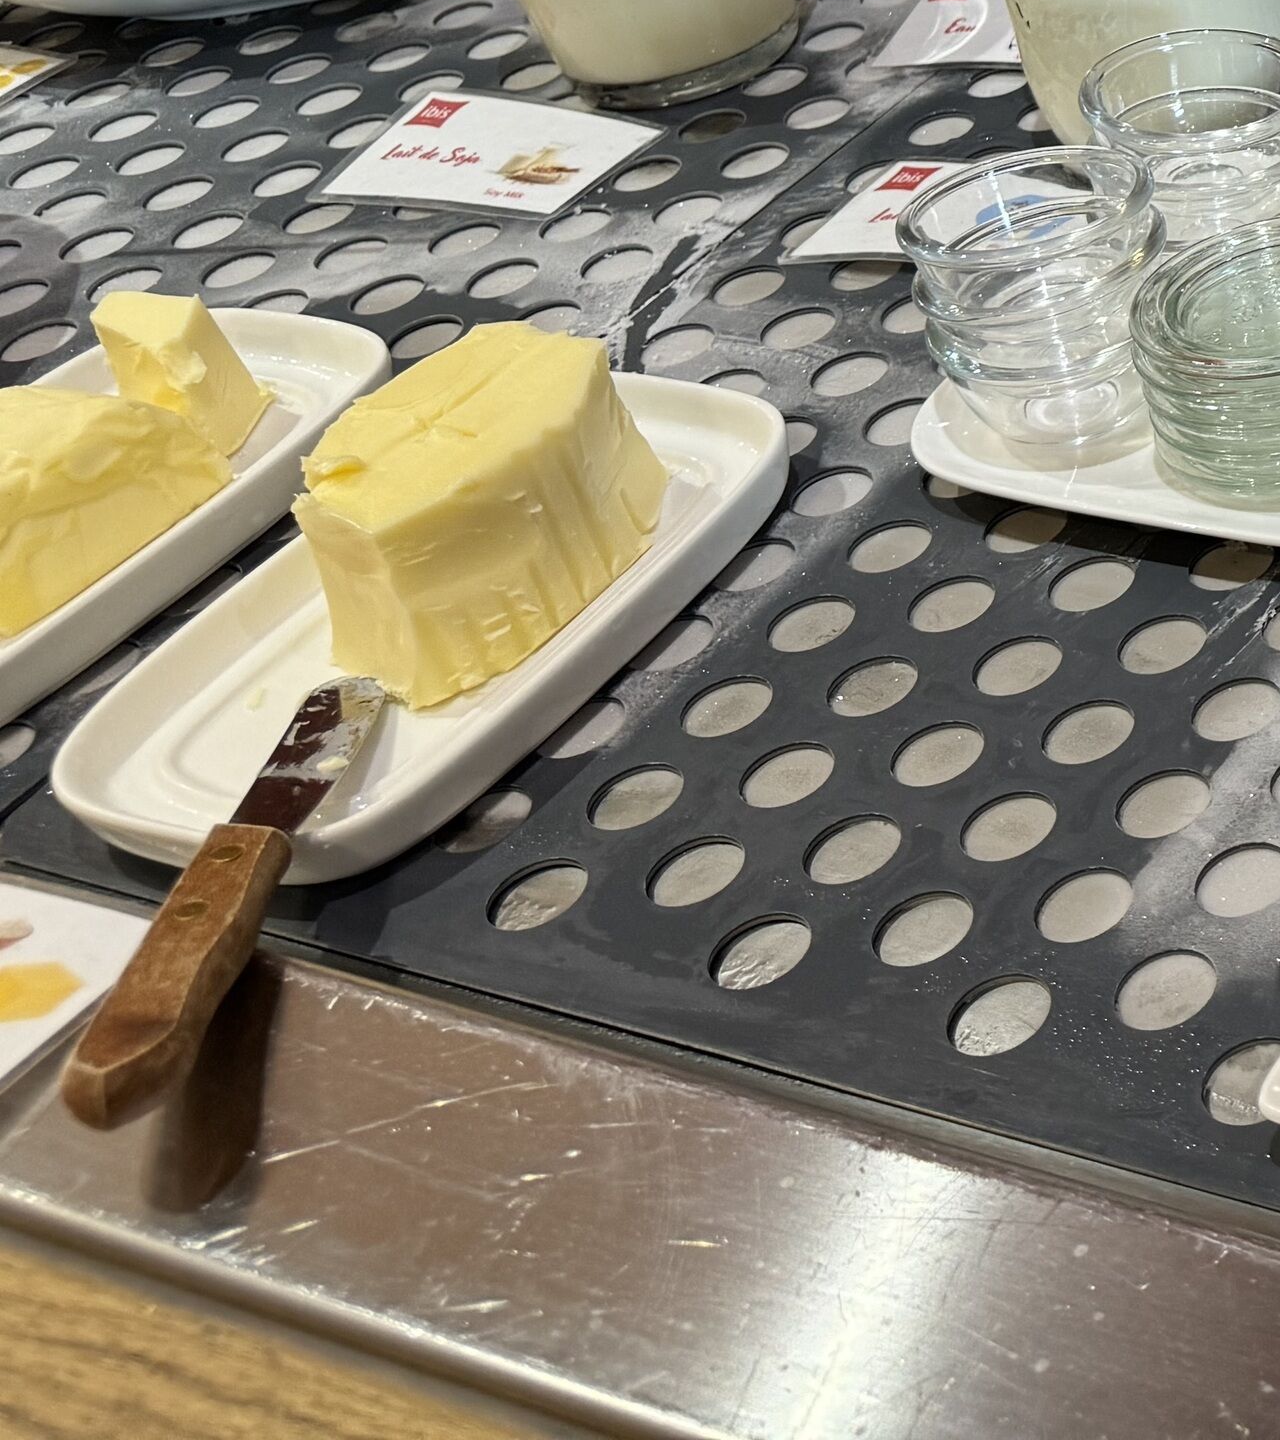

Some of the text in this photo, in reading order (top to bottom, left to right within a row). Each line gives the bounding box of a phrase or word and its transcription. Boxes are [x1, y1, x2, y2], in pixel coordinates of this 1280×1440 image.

[944, 17, 977, 34] Eau
[419, 105, 453, 119] ibis
[380, 143, 423, 160] Lait
[418, 146, 440, 160] de
[890, 171, 925, 183] ibis
